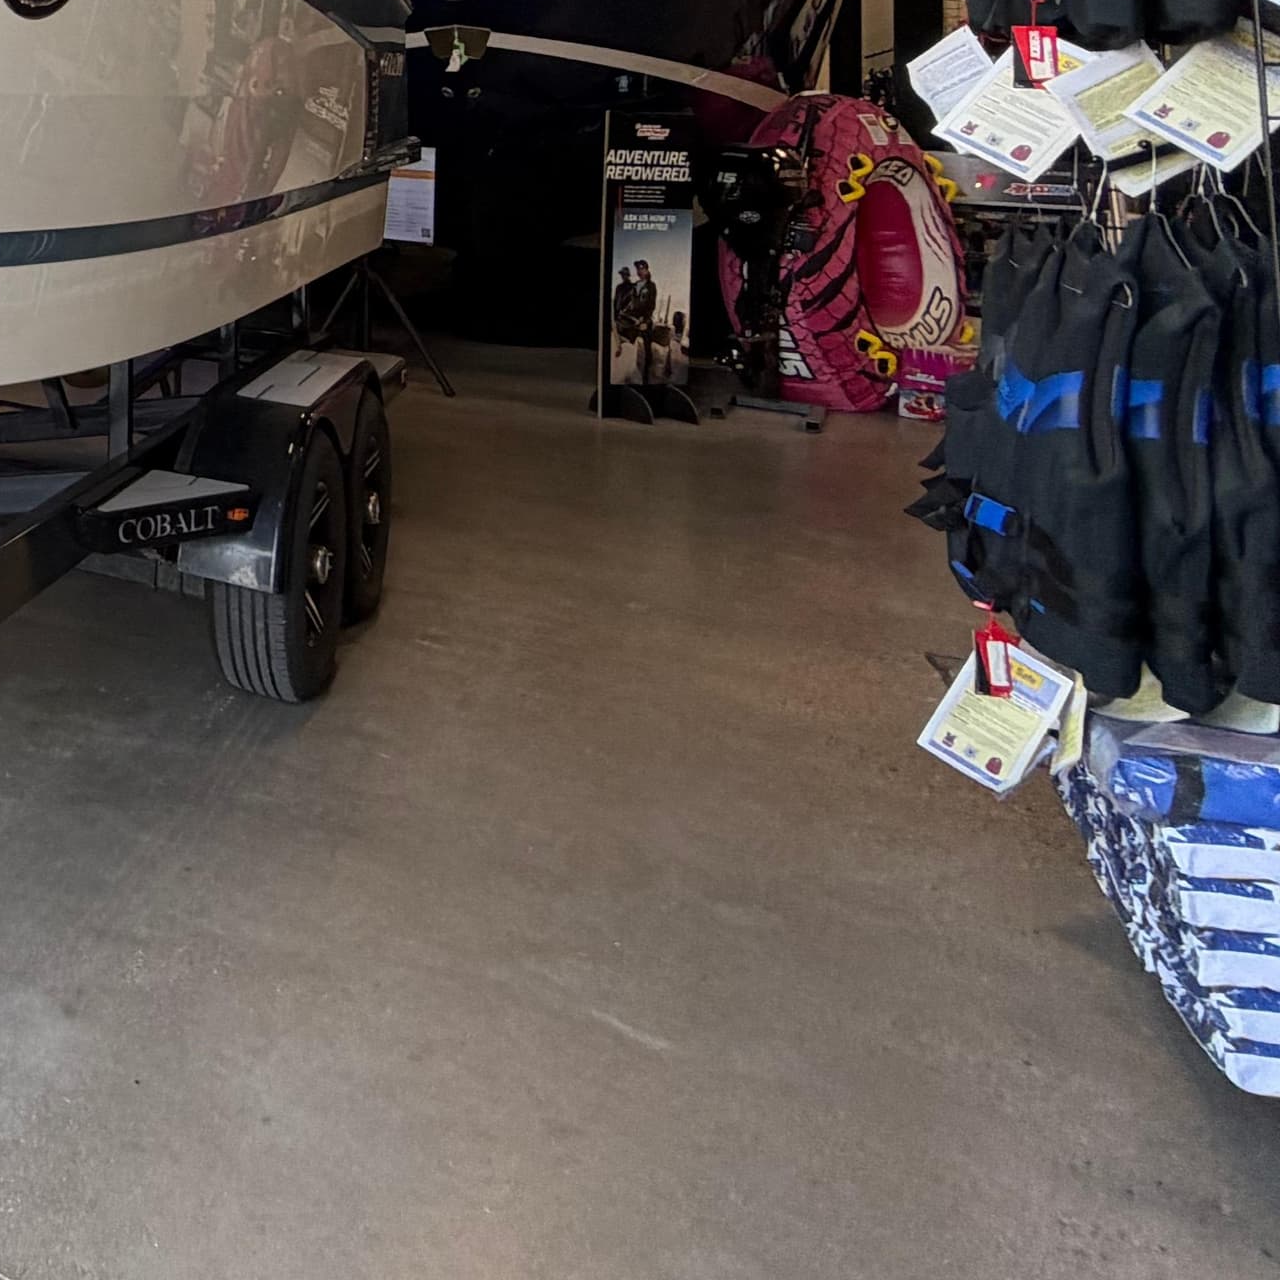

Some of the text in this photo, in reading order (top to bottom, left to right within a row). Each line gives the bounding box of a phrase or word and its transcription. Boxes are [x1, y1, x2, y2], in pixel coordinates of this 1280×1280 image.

[606, 149, 690, 167] ADVENTURE,
[606, 165, 692, 182] REPOWERED.
[118, 505, 221, 544] COBALT
